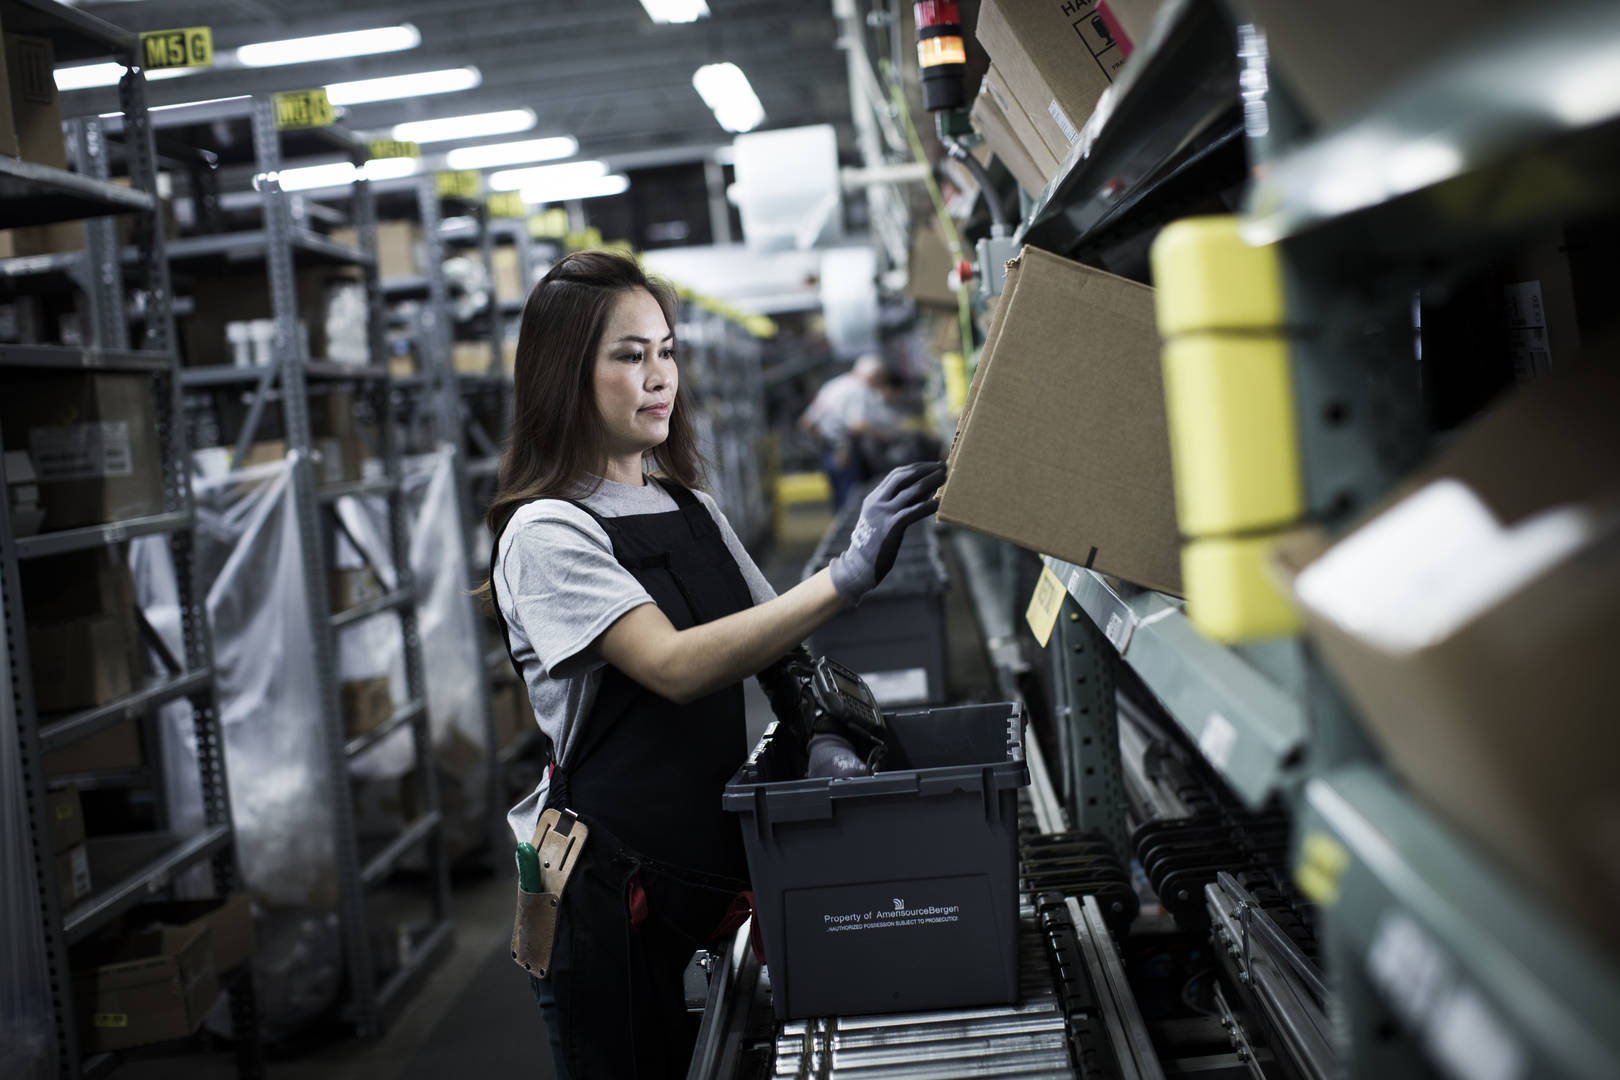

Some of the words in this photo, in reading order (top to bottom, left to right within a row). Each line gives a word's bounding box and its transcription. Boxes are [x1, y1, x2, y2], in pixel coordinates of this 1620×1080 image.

[145, 34, 186, 66] M5
[191, 33, 206, 62] G
[824, 914, 861, 924] Property
[864, 911, 872, 920] of
[876, 905, 959, 920] AmerisourceBergen
[863, 921, 895, 929] POSSESSION
